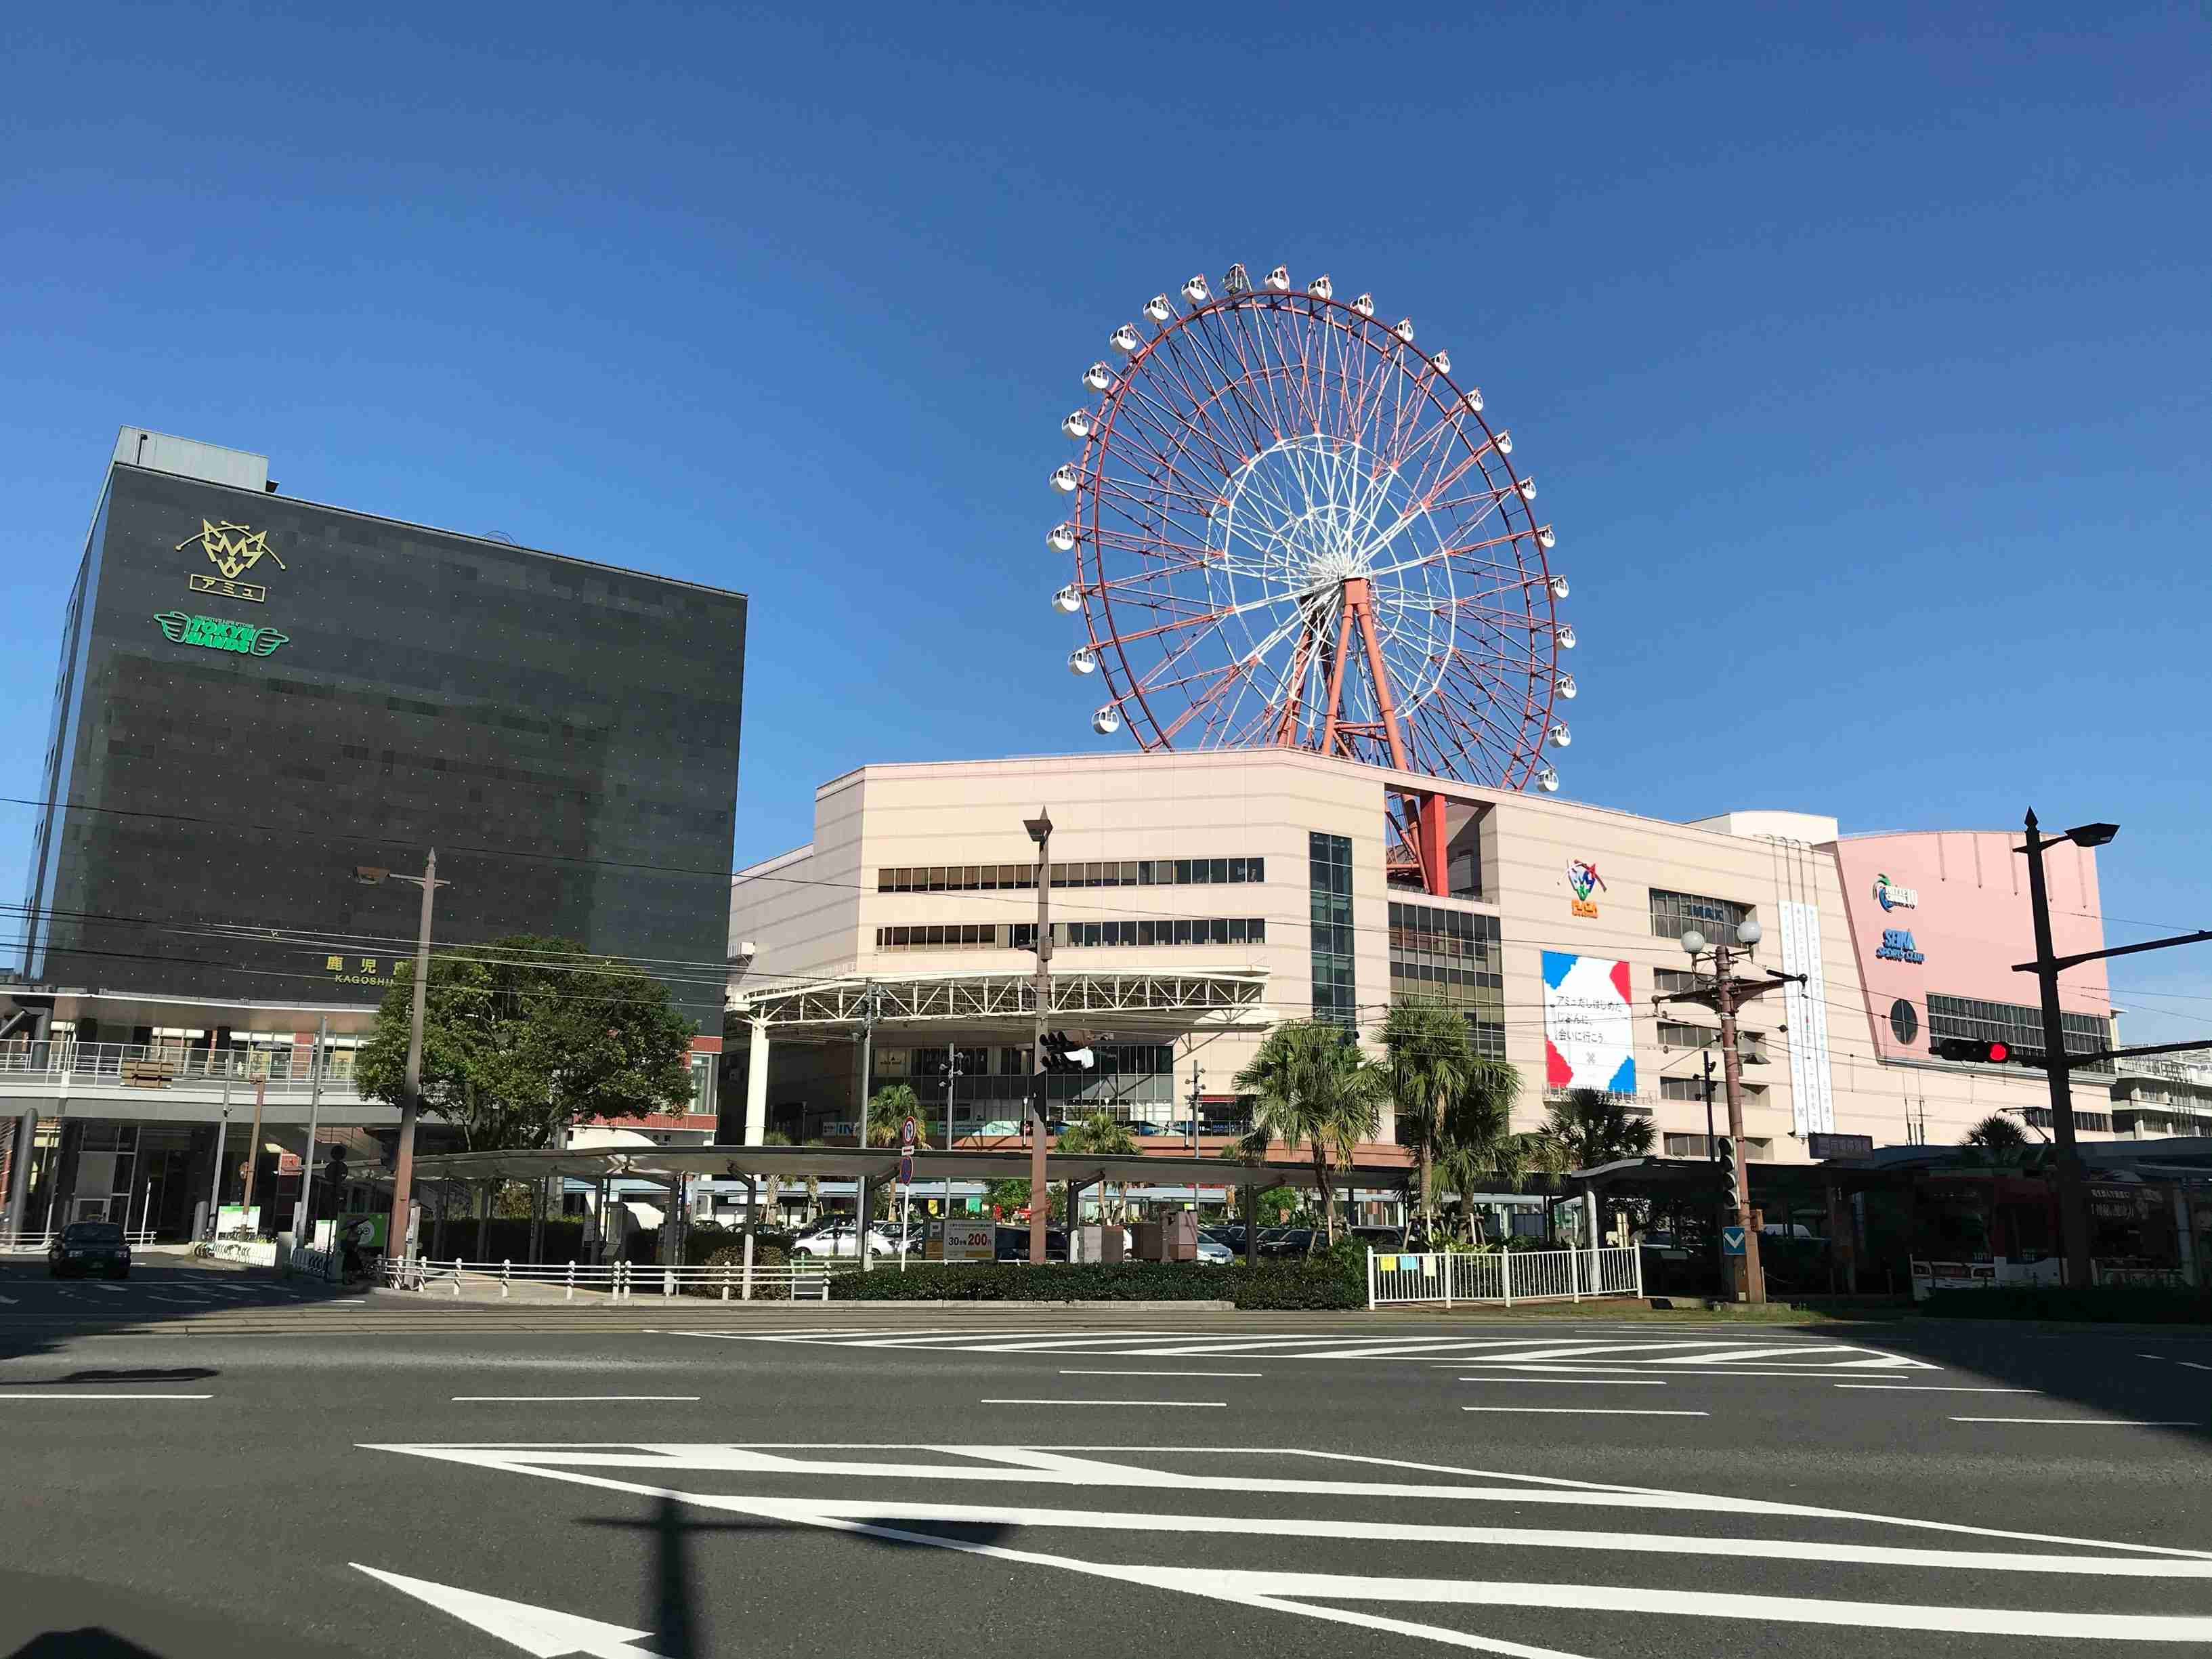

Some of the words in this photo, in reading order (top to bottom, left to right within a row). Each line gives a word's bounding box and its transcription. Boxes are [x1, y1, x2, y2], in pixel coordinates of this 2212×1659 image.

[202, 579, 253, 597] アミュ
[192, 617, 256, 642] TOKYU
[185, 630, 250, 654] HANDS
